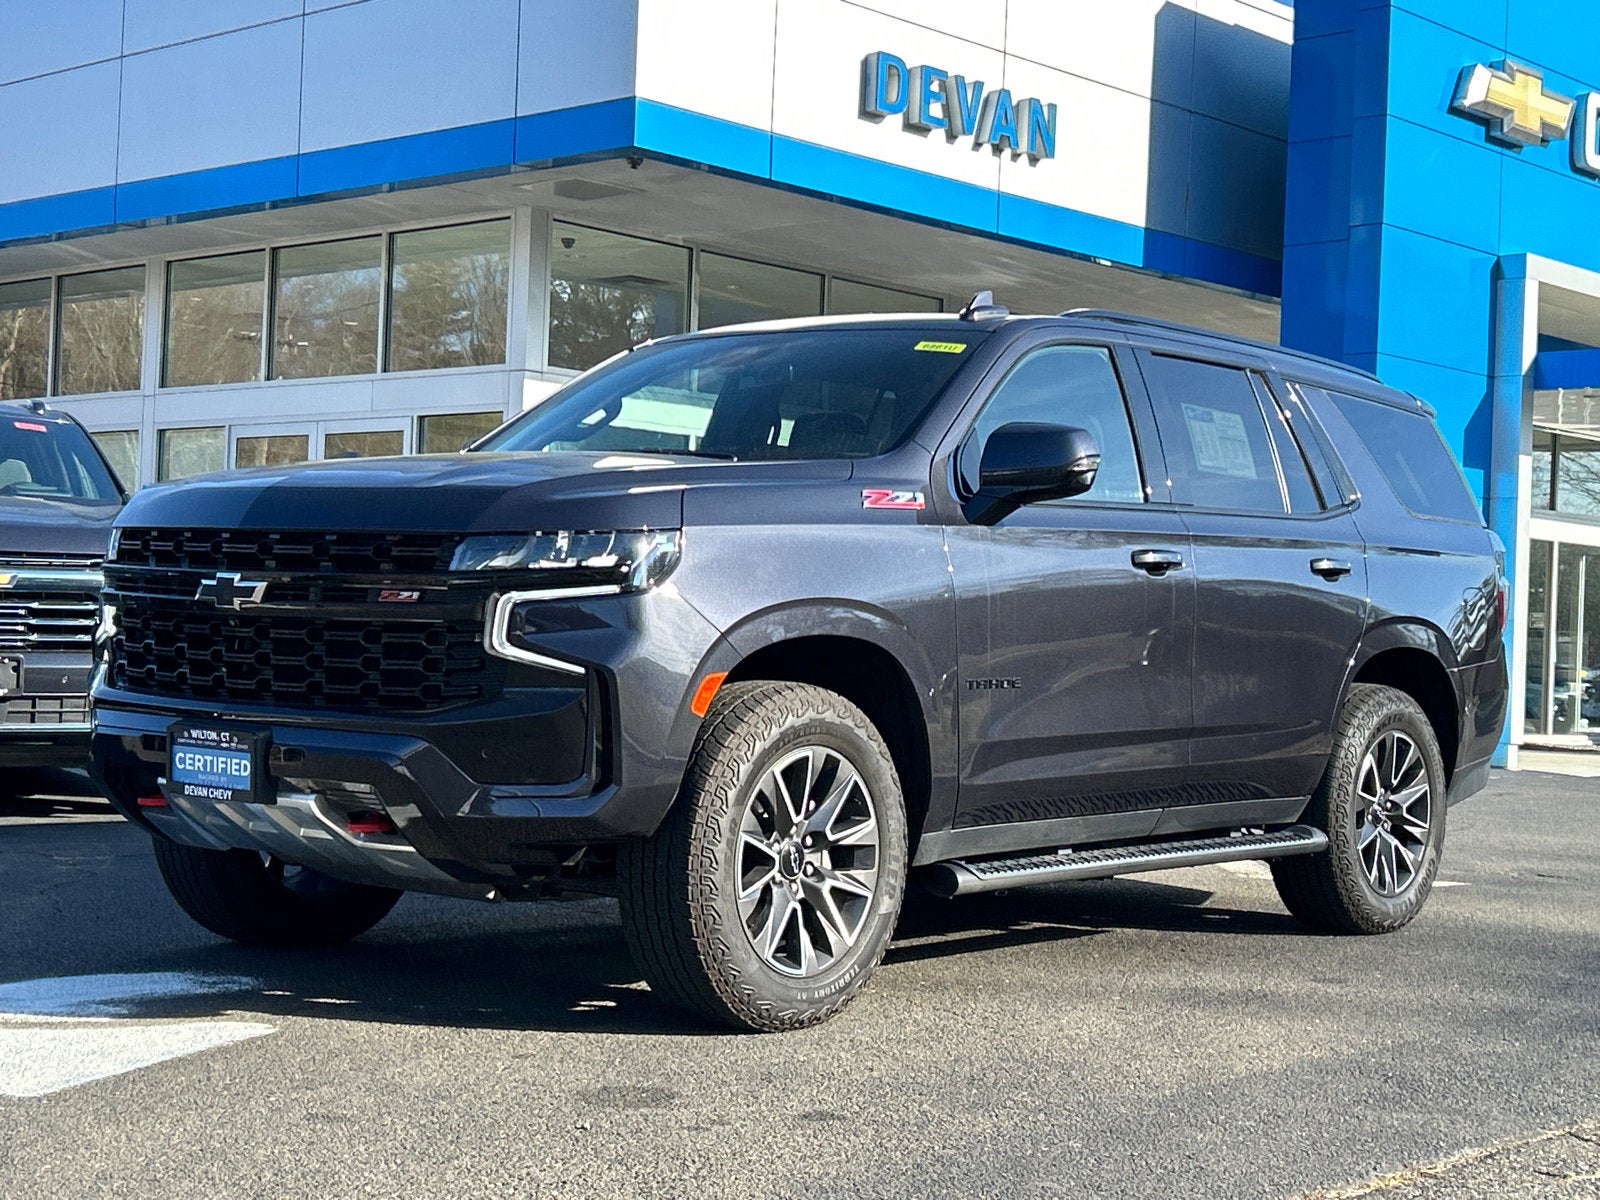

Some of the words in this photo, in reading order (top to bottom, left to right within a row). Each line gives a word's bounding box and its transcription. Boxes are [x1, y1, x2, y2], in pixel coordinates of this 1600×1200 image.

[866, 50, 1057, 159] DEVAN
[861, 489, 926, 510] Z71
[379, 590, 420, 602] Z71
[965, 677, 1022, 690] TAHOE
[220, 732, 230, 741] CT
[175, 752, 250, 776] CERTIFIED
[184, 784, 207, 798] DEVAN
[208, 788, 232, 800] CHEVY
[813, 964, 860, 999] TERRITORY
